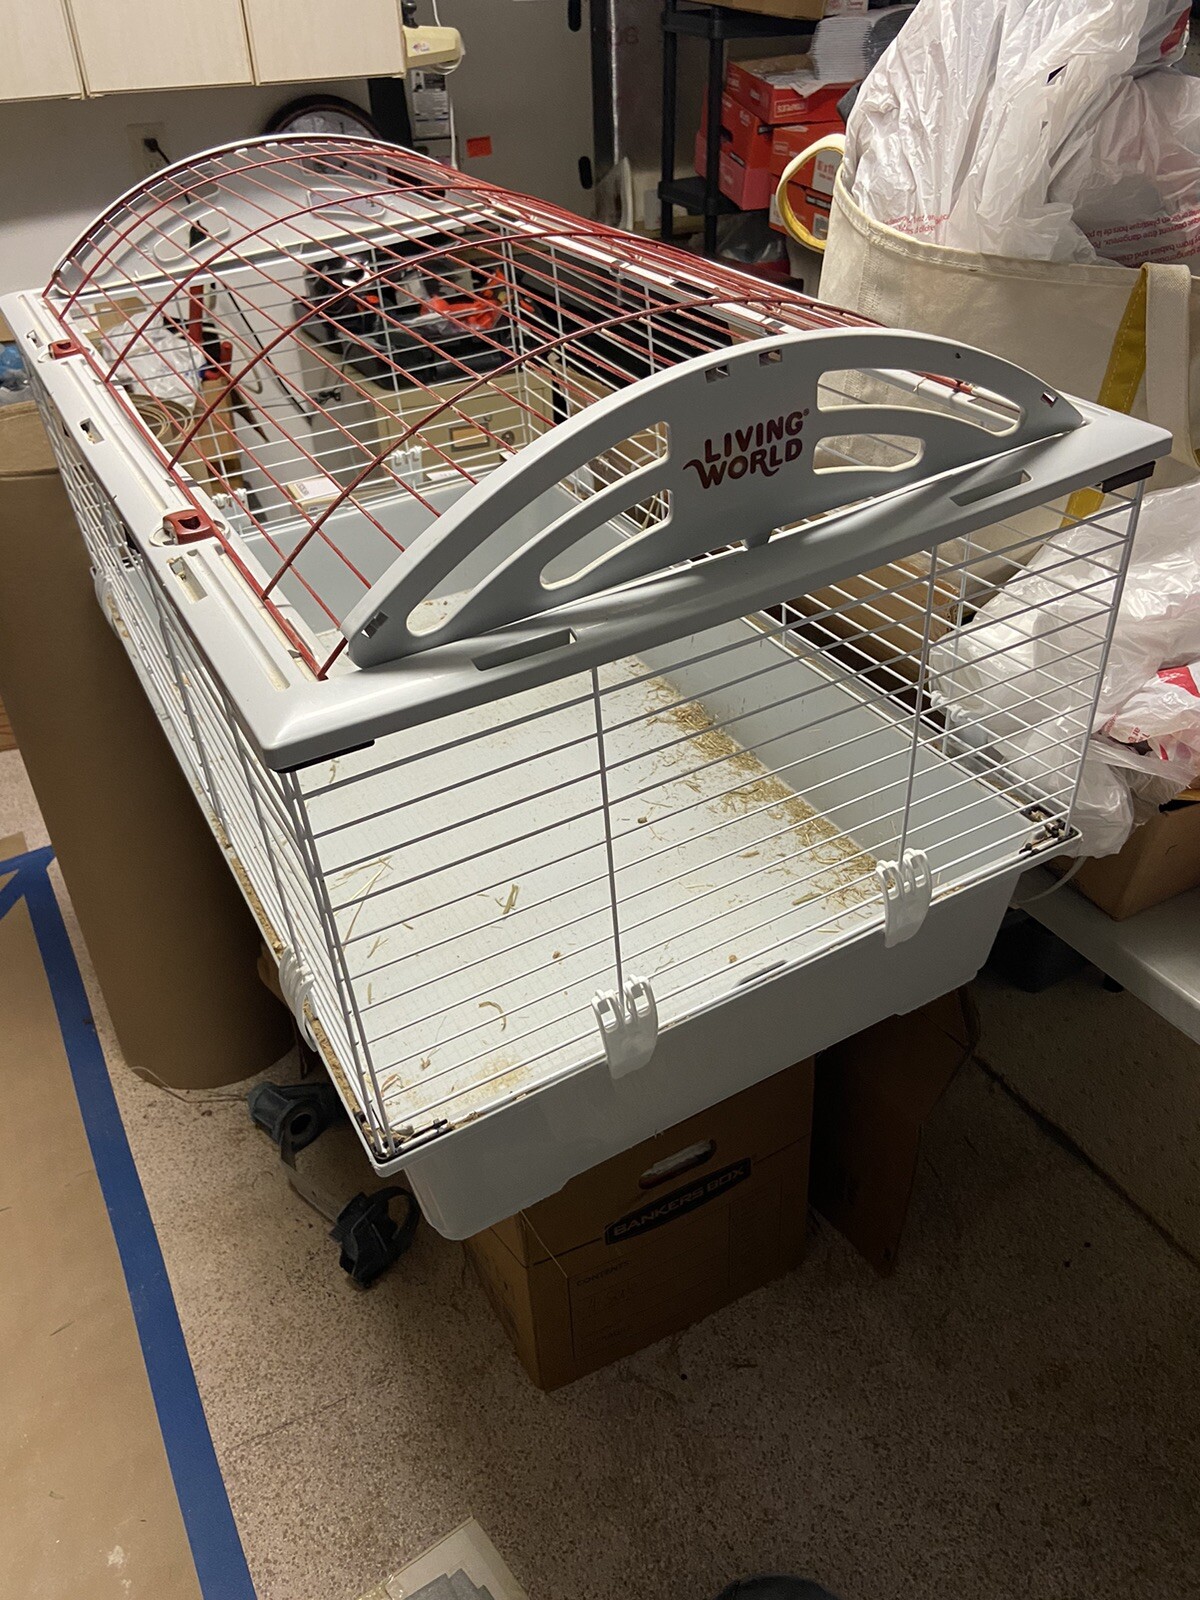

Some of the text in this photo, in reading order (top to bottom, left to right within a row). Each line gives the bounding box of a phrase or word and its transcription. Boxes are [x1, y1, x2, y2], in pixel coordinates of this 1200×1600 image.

[682, 437, 803, 490] WORLD
[704, 411, 804, 464] LIVING
[613, 1165, 745, 1236] BANKERS BOX
